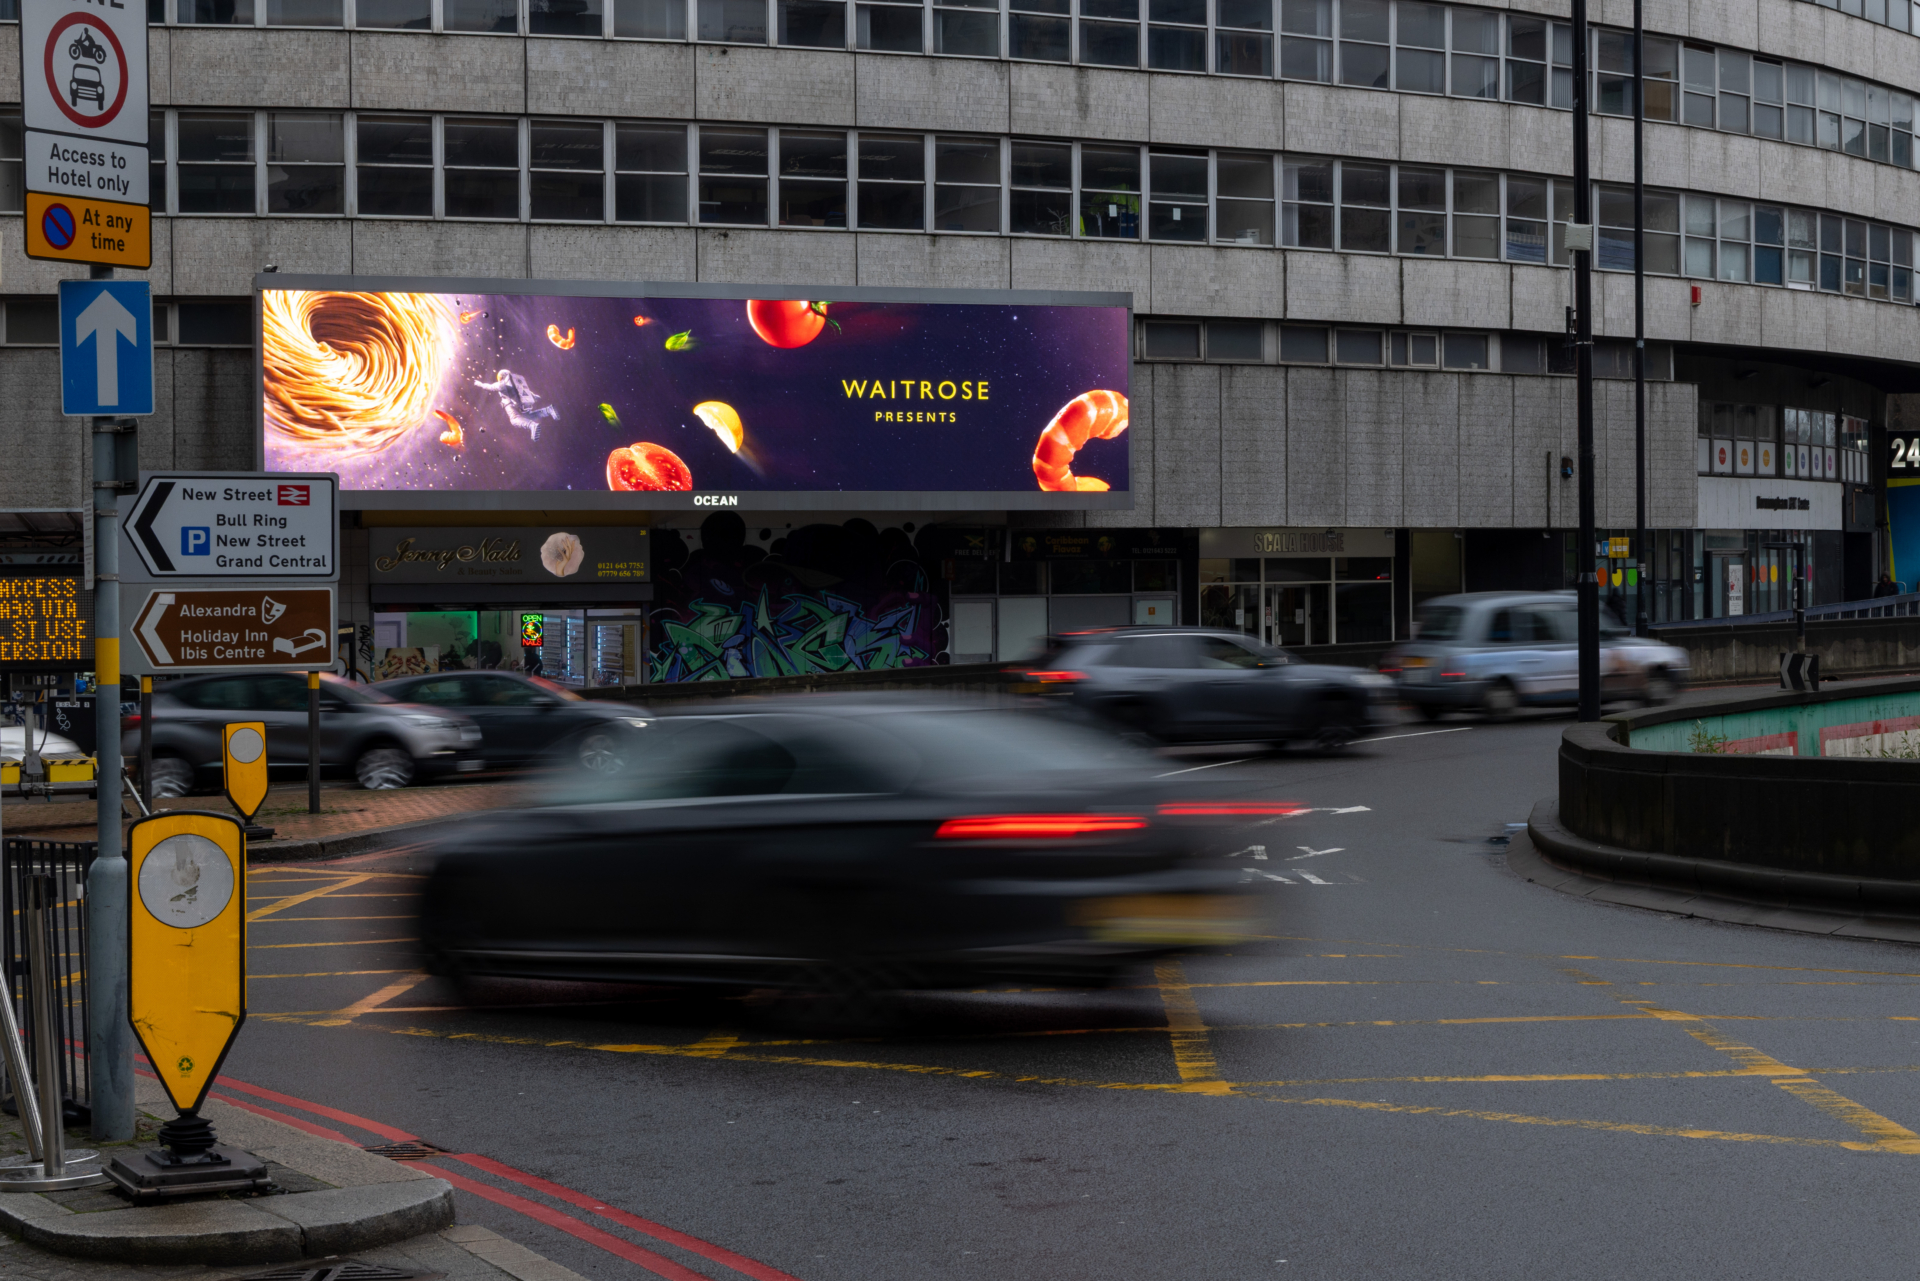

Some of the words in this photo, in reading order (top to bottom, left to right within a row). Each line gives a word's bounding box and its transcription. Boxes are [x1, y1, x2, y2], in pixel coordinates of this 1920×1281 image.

[50, 143, 105, 167] Access
[111, 153, 127, 170] to
[48, 166, 92, 189] Hotel
[97, 171, 130, 195] only
[82, 208, 101, 227] At
[106, 215, 133, 233] any
[91, 232, 125, 252] time
[842, 380, 990, 400] WAITROSE
[875, 411, 957, 423] PRESENTS
[1891, 437, 1920, 468] 24
[182, 488, 217, 501] New
[223, 487, 273, 502] Street
[693, 495, 738, 507] OCEAN
[216, 514, 247, 527] Bull
[253, 514, 287, 529] Ring
[188, 530, 206, 554] P
[216, 535, 250, 548] New
[256, 534, 306, 548] Street
[1045, 536, 1089, 545] Caribbean
[1254, 533, 1298, 553] SCALA
[1299, 533, 1345, 552] HOUSE
[375, 537, 456, 572] Jenny
[457, 537, 522, 563] Nails
[1052, 545, 1082, 554] Flavaz
[216, 555, 263, 568] Grand
[268, 555, 327, 568] Central
[597, 562, 613, 570] 0121
[614, 562, 627, 570] 643
[468, 567, 497, 577] Beauty
[499, 567, 523, 575] Salon
[0, 579, 76, 598] ACCESS
[0, 600, 34, 619] A38
[42, 599, 77, 618] VIA
[180, 603, 257, 618] Alexandra
[522, 614, 543, 622] OPEN
[12, 621, 37, 640] ST
[45, 620, 86, 639] USE
[181, 630, 239, 646] Holiday
[245, 630, 269, 642] Inn
[522, 638, 543, 646] NAILS
[181, 647, 208, 660] Ibis
[213, 646, 265, 659] Centre
